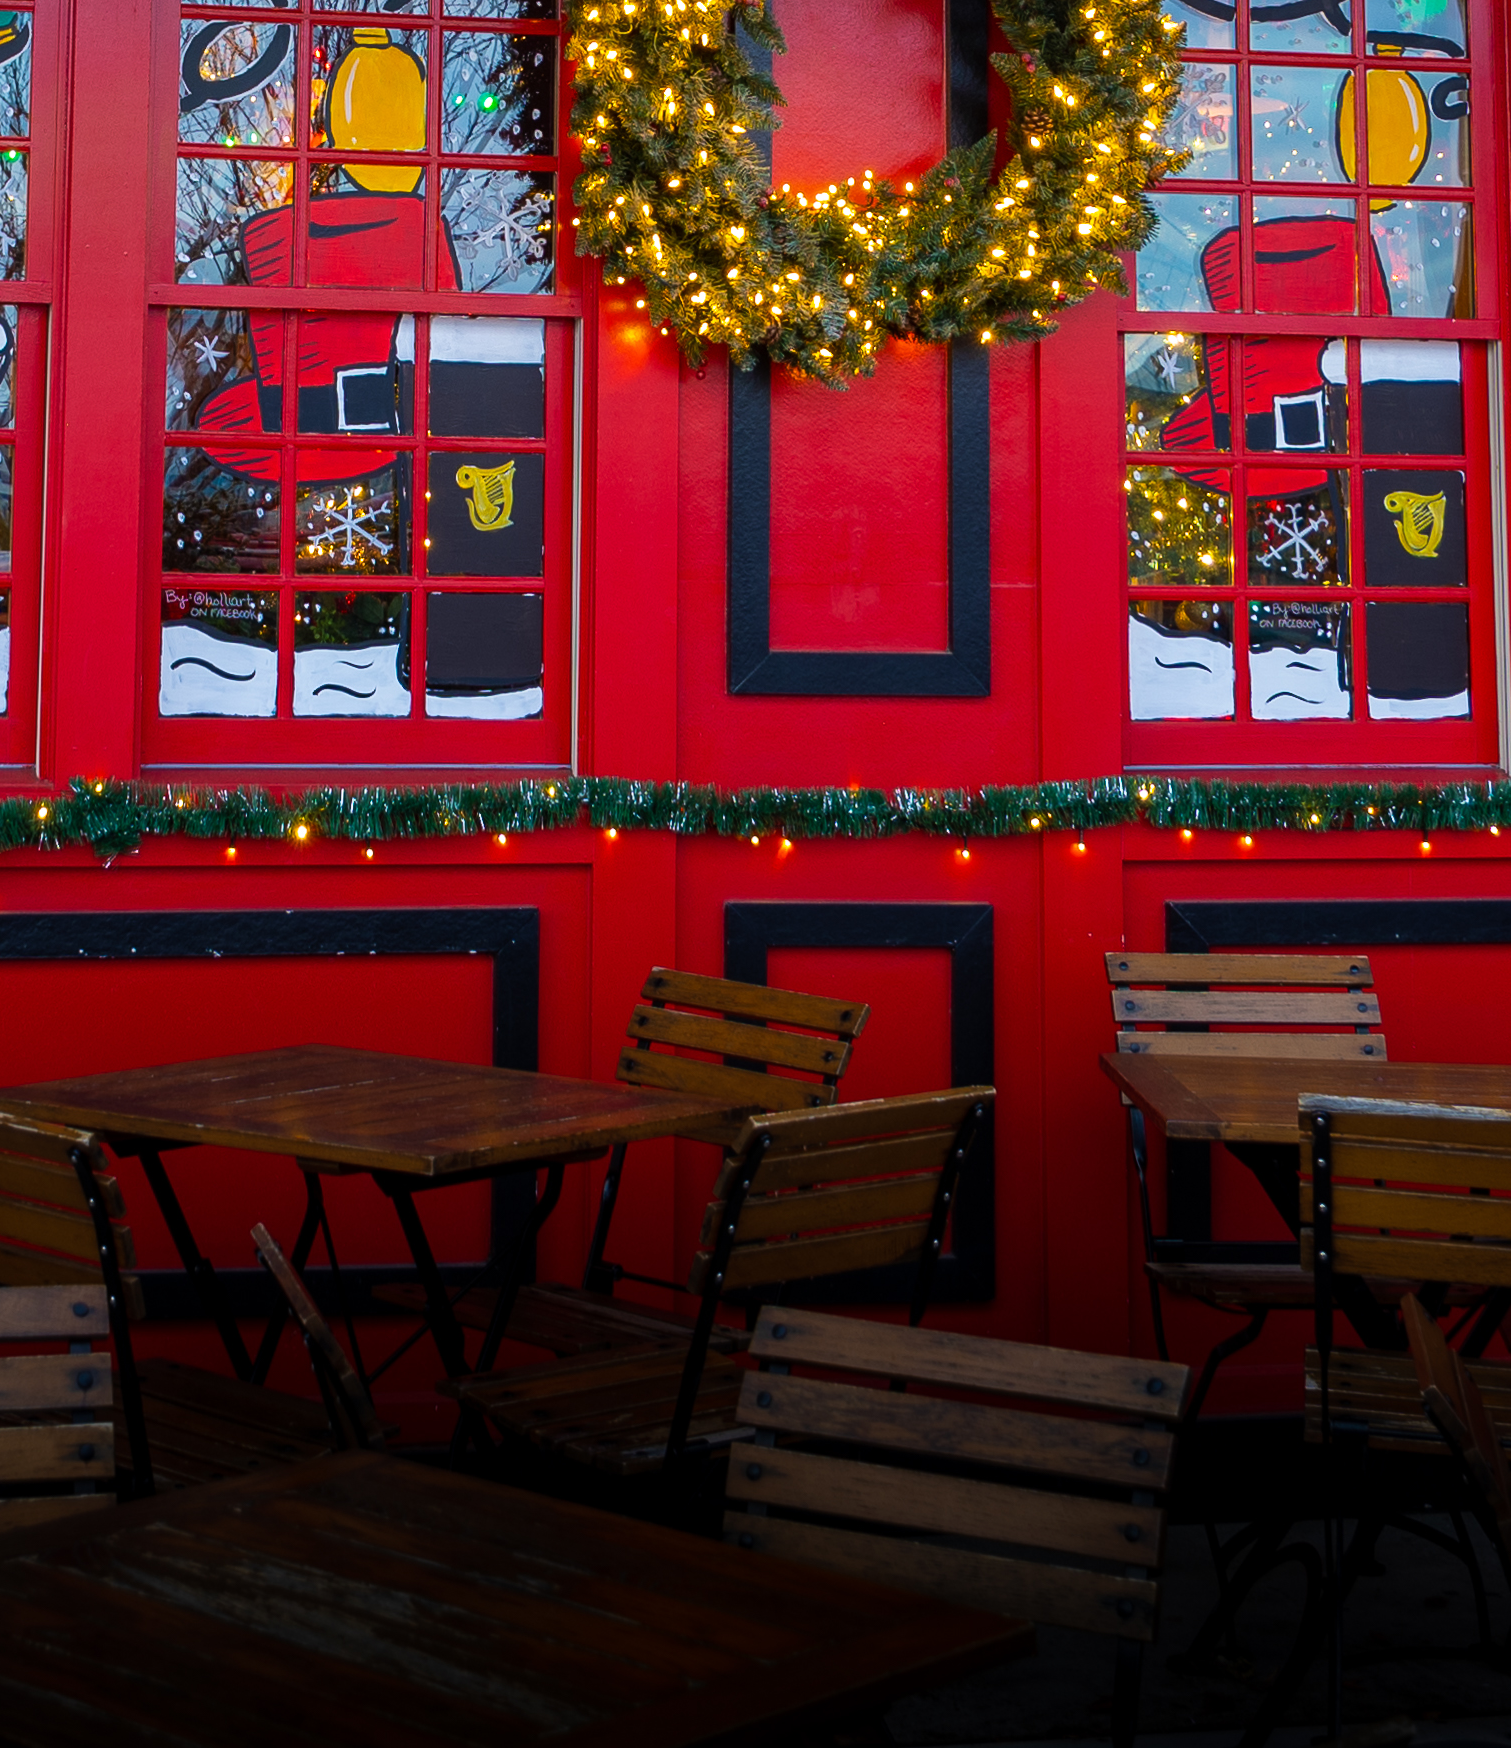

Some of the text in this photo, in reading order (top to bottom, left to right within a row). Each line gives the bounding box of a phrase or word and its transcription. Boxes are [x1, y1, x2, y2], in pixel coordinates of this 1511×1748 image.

[190, 607, 259, 620] ON FACEBOOK
[1259, 619, 1275, 629] ON
